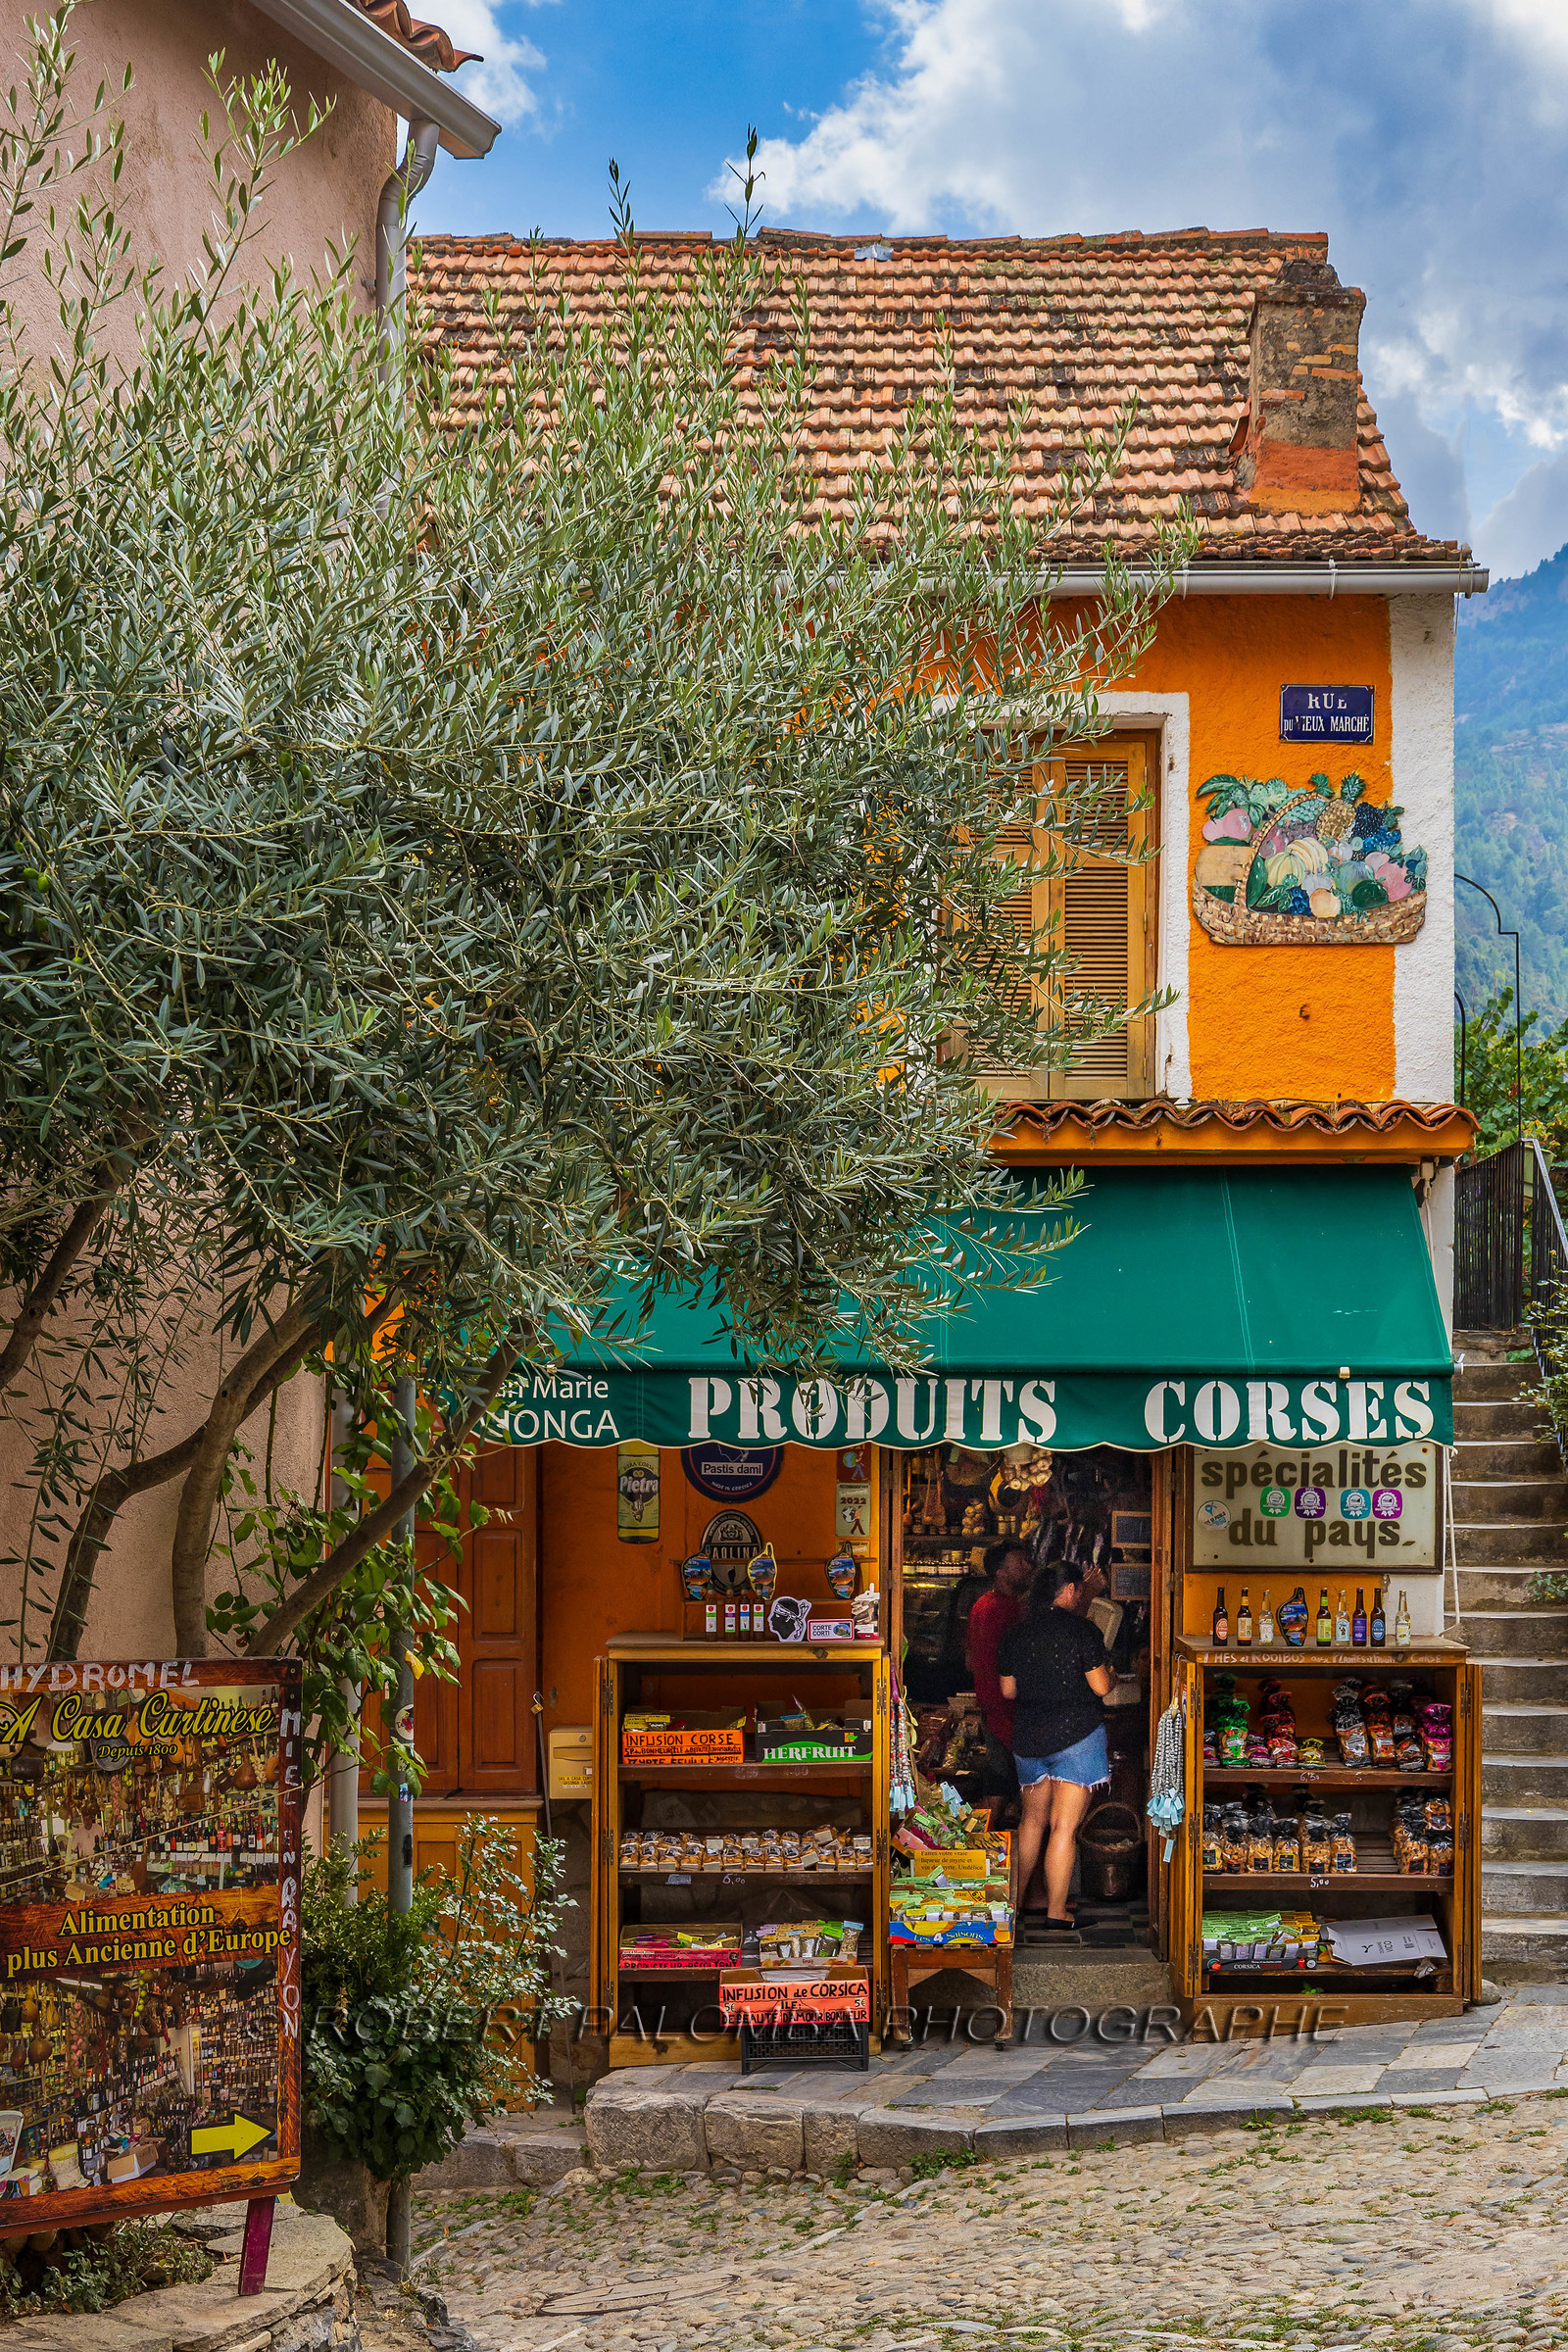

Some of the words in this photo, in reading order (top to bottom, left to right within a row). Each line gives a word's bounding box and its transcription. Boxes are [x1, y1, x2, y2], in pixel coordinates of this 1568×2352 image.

[1307, 693, 1348, 709] RUE
[1283, 718, 1294, 732] DU
[1330, 714, 1370, 732] MARCHÉ
[532, 1374, 609, 1398] Marie
[688, 1377, 1057, 1444] PRODUITS
[1144, 1380, 1435, 1444] CORSES
[703, 1464, 735, 1474] Pastis
[737, 1464, 762, 1474] dami
[1201, 1449, 1427, 1499] spécialités
[619, 1475, 660, 1493] Pietra
[840, 1496, 867, 1505] 2022
[1228, 1507, 1277, 1546] du
[712, 1546, 758, 1559] AOLINA
[1251, 1651, 1305, 1664] ROOIBOS
[0, 1661, 200, 1692] HYDROMEL
[0, 1695, 43, 1743] A
[52, 1693, 125, 1741] Casa
[139, 1690, 275, 1739] Curtinese
[626, 1733, 683, 1746] INFUSION
[690, 1733, 734, 1745] CORSE
[98, 1741, 145, 1762] Depuis
[148, 1742, 177, 1756] 1800
[762, 1746, 857, 1761] HERFRUIT
[58, 1901, 215, 1936] Alimentation
[933, 1932, 944, 1943] 4
[946, 1930, 985, 1941] Saisons
[6, 1945, 59, 1979] plus
[64, 1939, 176, 1967] Ancienne
[182, 1928, 292, 1956] d'Europe
[723, 1984, 788, 2001] INFUSION
[793, 1987, 808, 1998] de
[810, 1982, 867, 1997] CORSICA
[724, 2002, 735, 2012] 5€
[855, 1998, 866, 2008] 5€
[721, 2014, 733, 2025] DE
[736, 2010, 778, 2025] BEAUTÉ
[825, 2010, 867, 2022] BONHEUR
